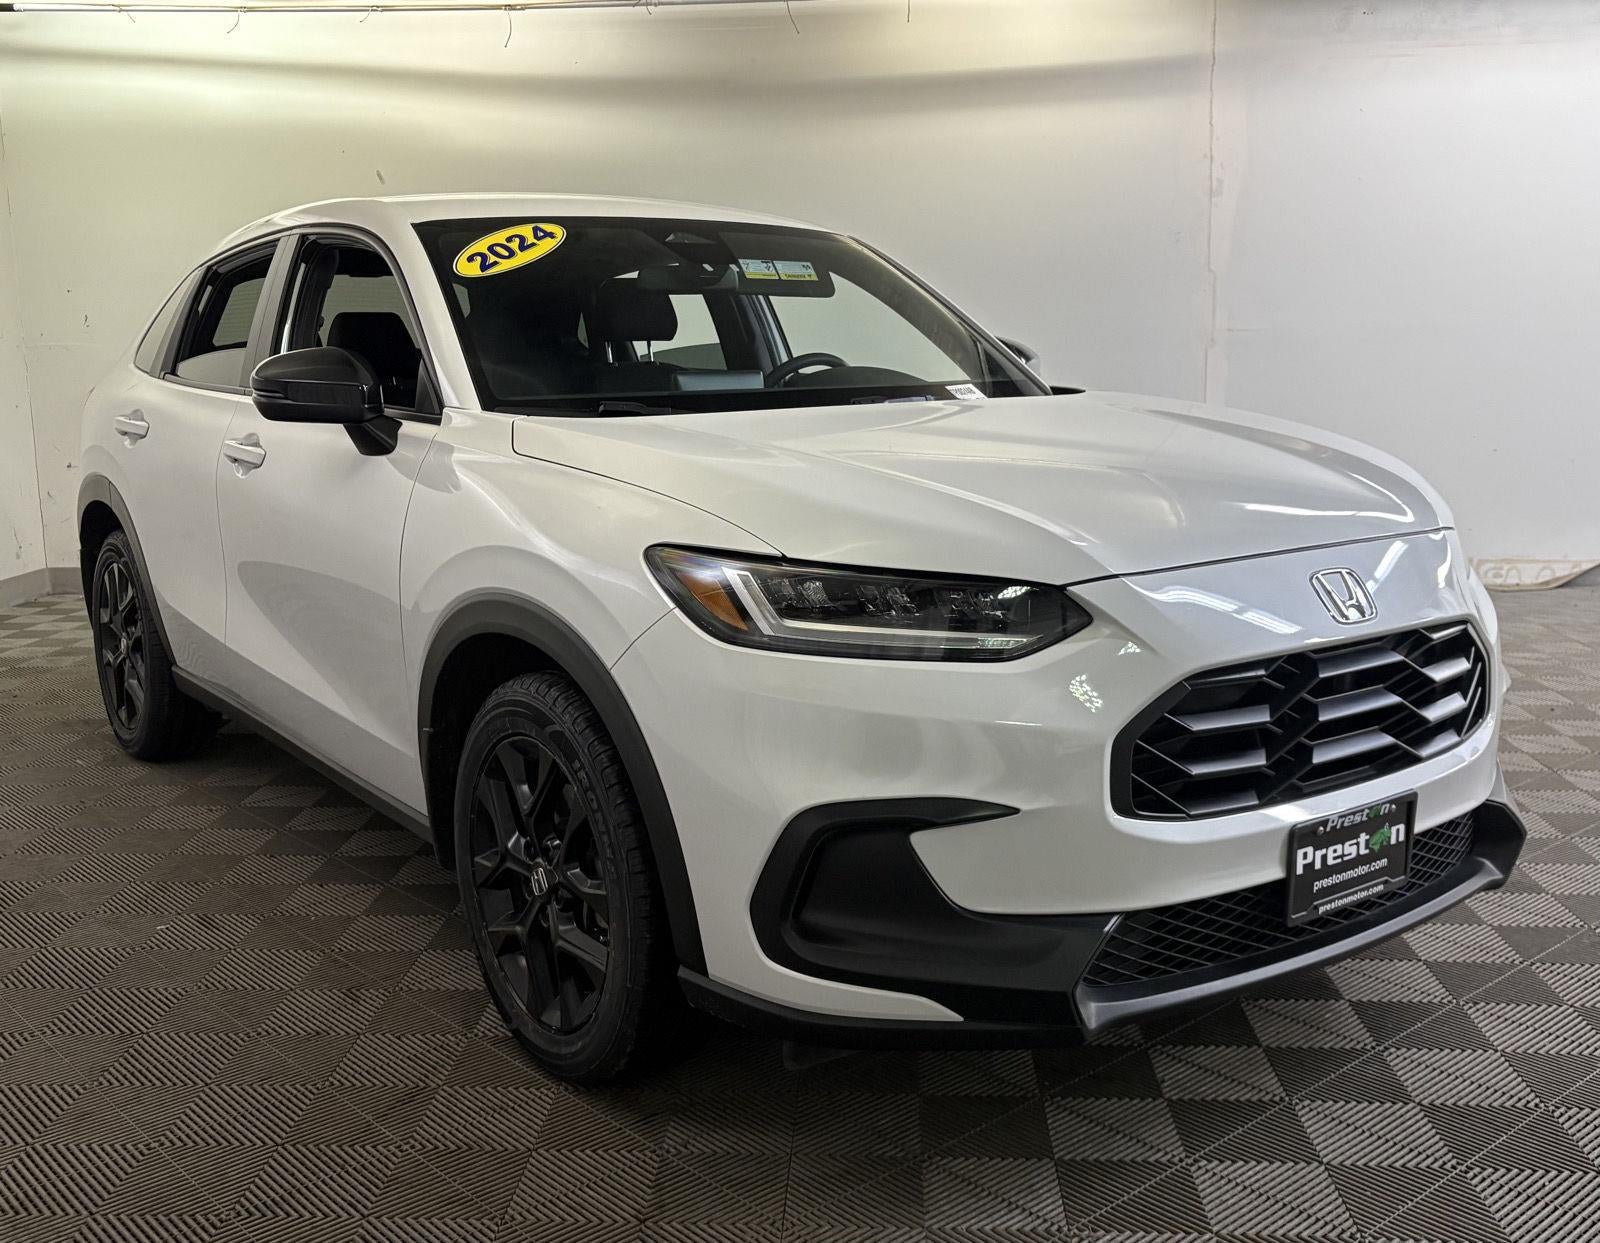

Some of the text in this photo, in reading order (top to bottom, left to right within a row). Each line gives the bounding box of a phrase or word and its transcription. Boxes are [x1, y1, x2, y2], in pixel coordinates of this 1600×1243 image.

[466, 225, 557, 273] 2024
[1313, 858, 1388, 893] prestonmotor.com
[1318, 884, 1384, 915] prestonmotor.com
